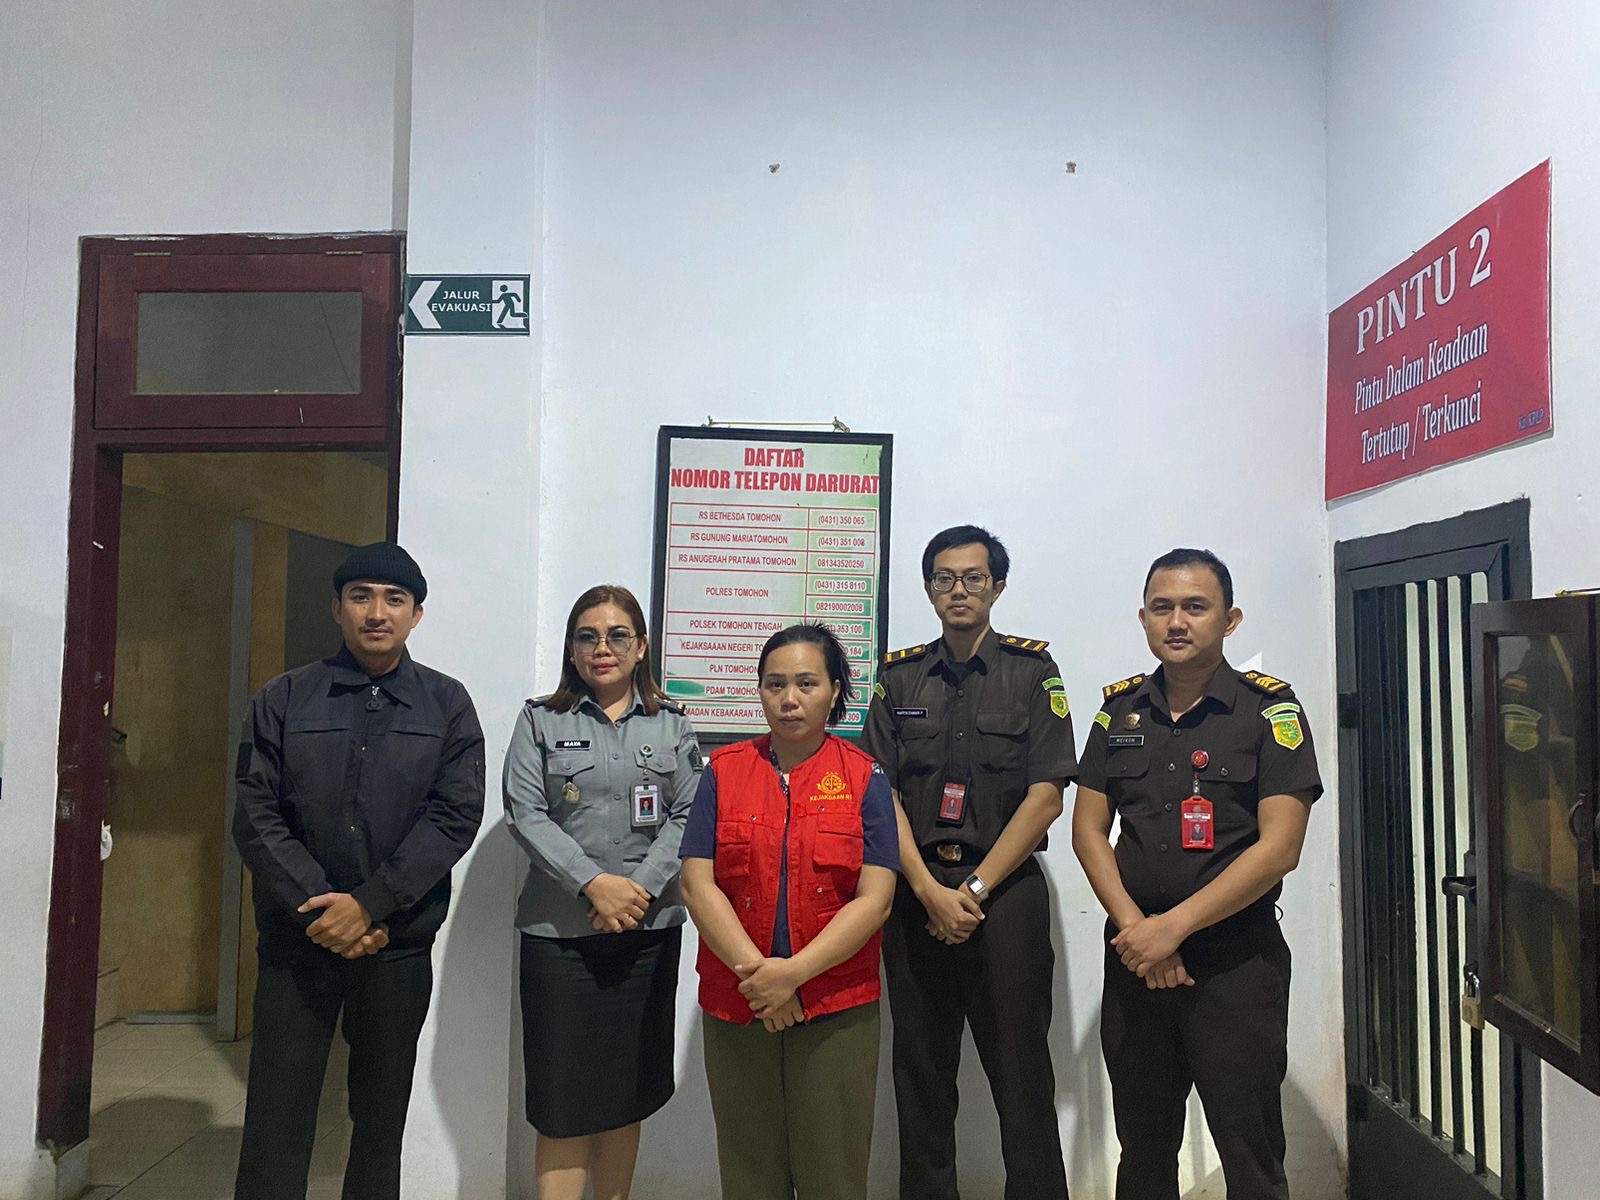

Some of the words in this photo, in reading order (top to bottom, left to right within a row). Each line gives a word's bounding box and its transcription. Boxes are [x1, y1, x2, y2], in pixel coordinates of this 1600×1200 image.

[443, 291, 480, 300] JALUR
[1356, 246, 1458, 355] PINTU
[1469, 226, 1492, 288] 2
[431, 303, 491, 312] EVAKUASI
[1354, 377, 1383, 415] Pintu
[1386, 355, 1424, 401] Dalam
[1427, 322, 1488, 381] Keadaan
[1361, 418, 1410, 465] Tertutup
[1412, 405, 1420, 457] /
[1422, 380, 1482, 443] Terkunci
[744, 447, 805, 468] DAFTAR
[671, 469, 730, 489] NOMOR
[735, 471, 801, 492] TELEPON
[805, 473, 880, 494] DARURAT
[699, 511, 708, 520] RS
[710, 512, 745, 521] BETHESDA
[747, 513, 781, 522] TOMOHON
[818, 515, 839, 525] (0431)
[840, 516, 851, 524] 350
[853, 517, 865, 525] 065
[690, 533, 699, 541] RS
[701, 533, 731, 542] GUNUNG
[818, 537, 839, 547] (0431)
[840, 538, 851, 546] 351
[689, 554, 727, 564] ANUGERAH
[728, 555, 761, 565] PRATAMA
[762, 557, 797, 566] TOMOHON
[817, 559, 864, 568] 081343520250
[815, 581, 835, 590] (0431)
[849, 582, 865, 590] 8110
[706, 587, 732, 596] POLRES
[734, 588, 769, 597] TOMOHON
[690, 620, 716, 629] POLSEK
[718, 621, 752, 630] TOMOHON
[754, 621, 782, 631] TENGAH
[837, 625, 849, 633] 353
[851, 625, 862, 634] 100
[727, 643, 753, 651] NEGERI
[850, 647, 861, 655] 184
[710, 664, 723, 673] PLN
[706, 686, 725, 695] PDAM
[711, 708, 753, 718] KEBAKARAN
